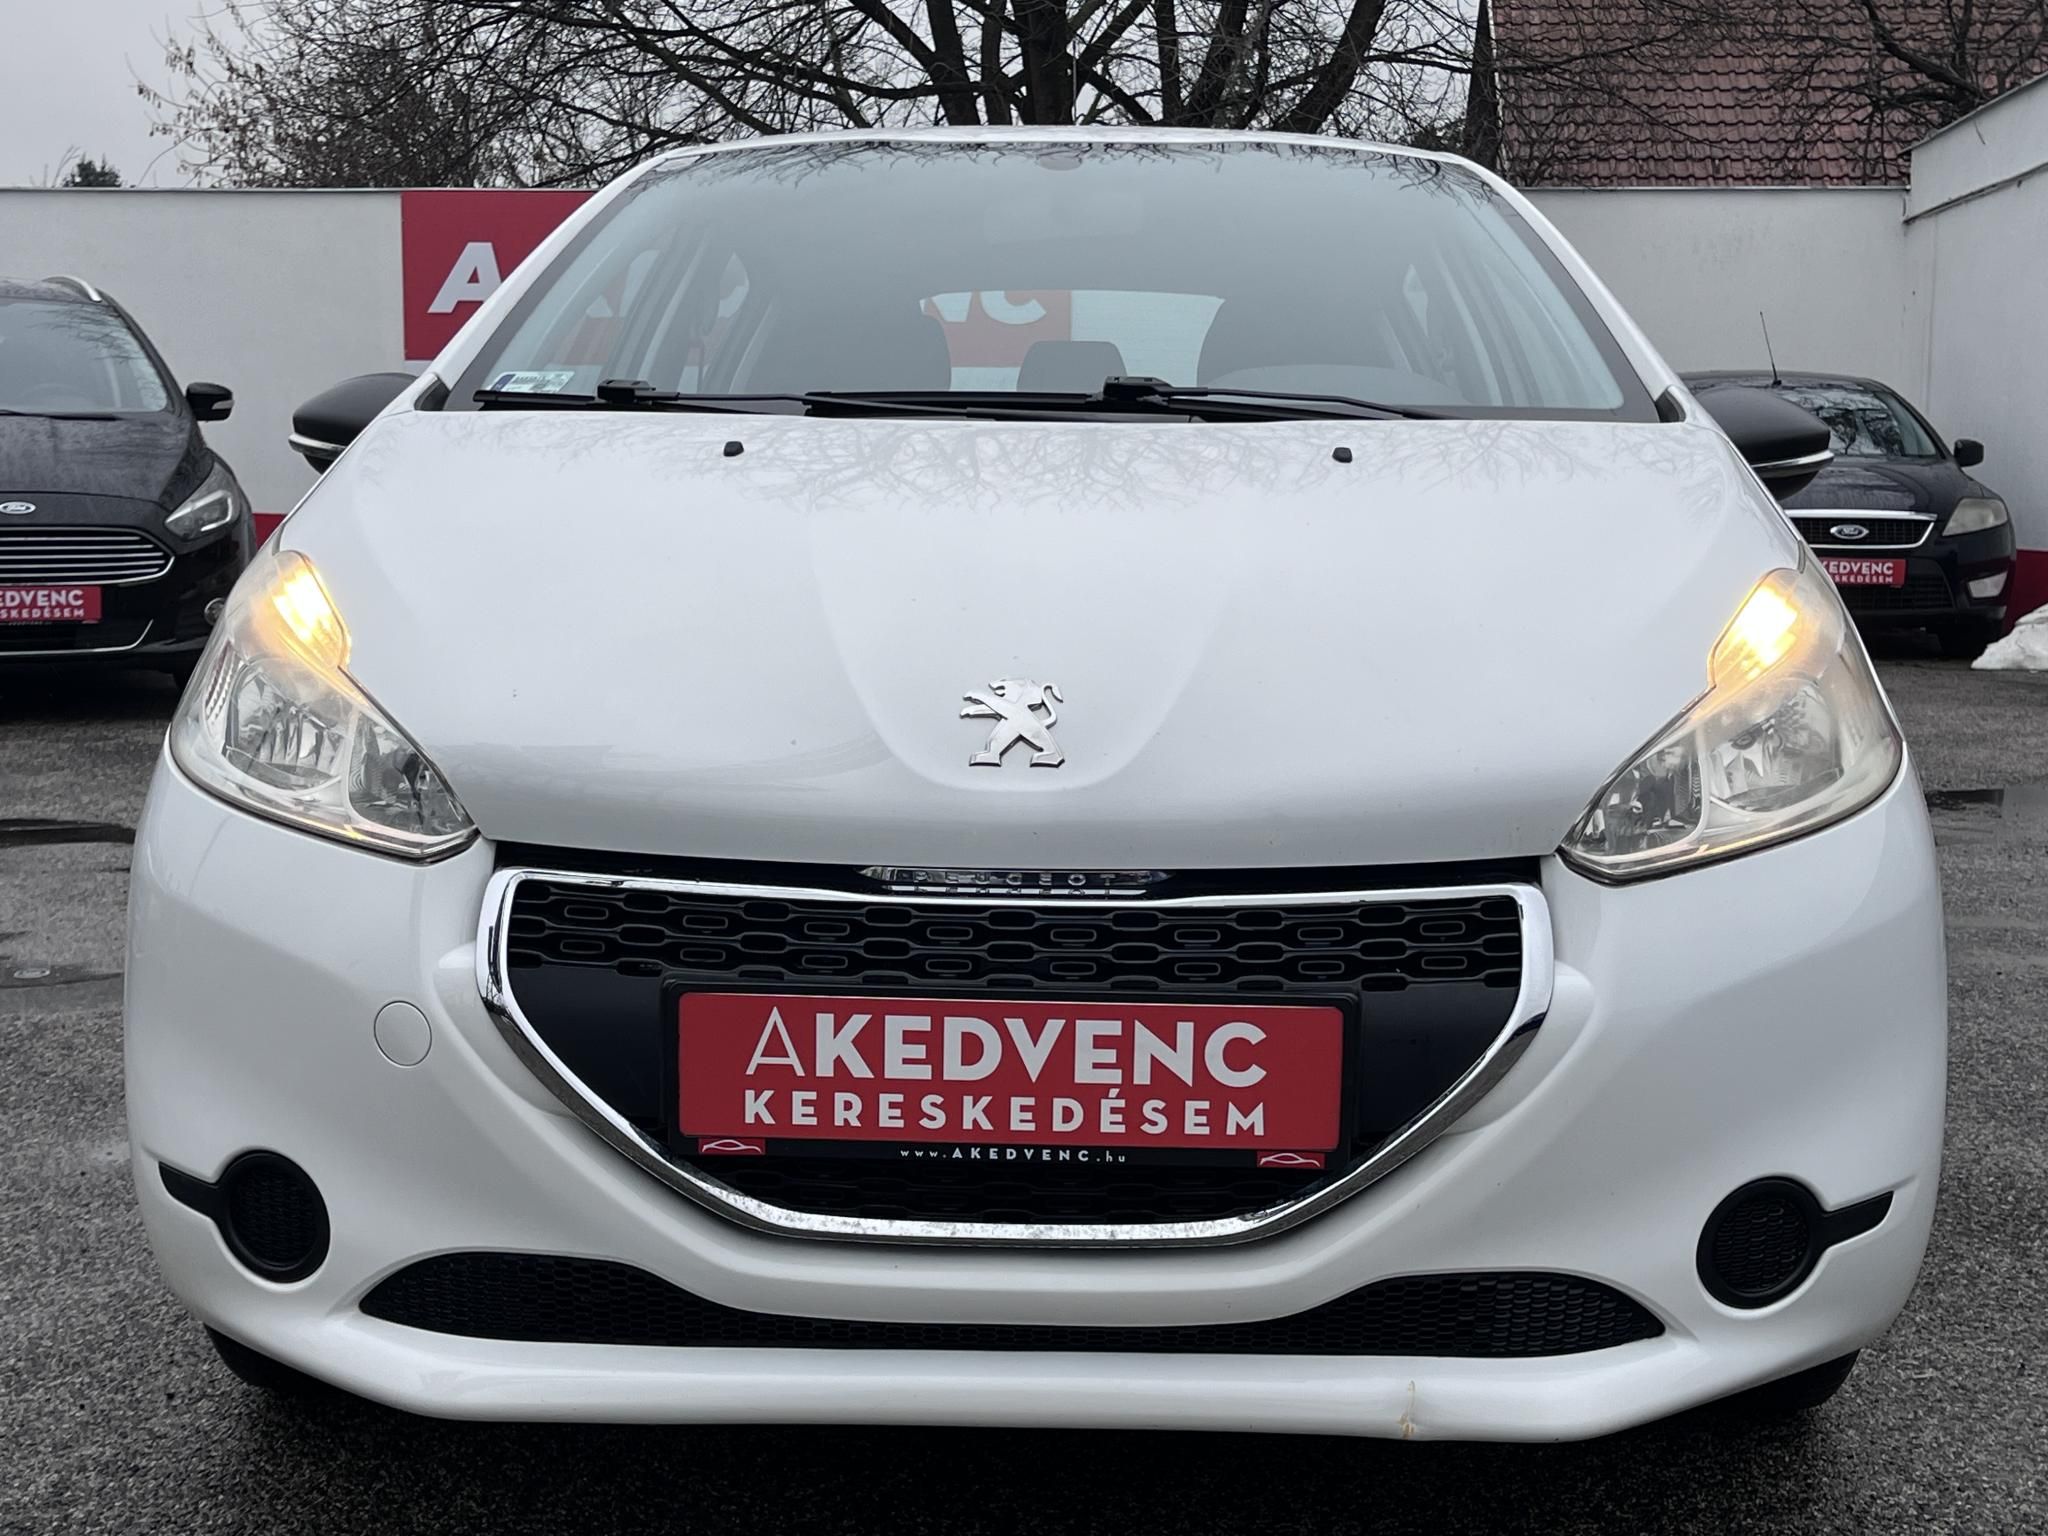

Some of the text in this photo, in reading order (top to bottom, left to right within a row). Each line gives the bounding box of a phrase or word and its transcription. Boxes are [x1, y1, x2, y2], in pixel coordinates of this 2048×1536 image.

[745, 1006, 1268, 1088] AKEDVENC
[744, 1088, 1265, 1136] KERESKEDÉSEM
[900, 1147, 1126, 1163] www.AKEDVENC.hu
